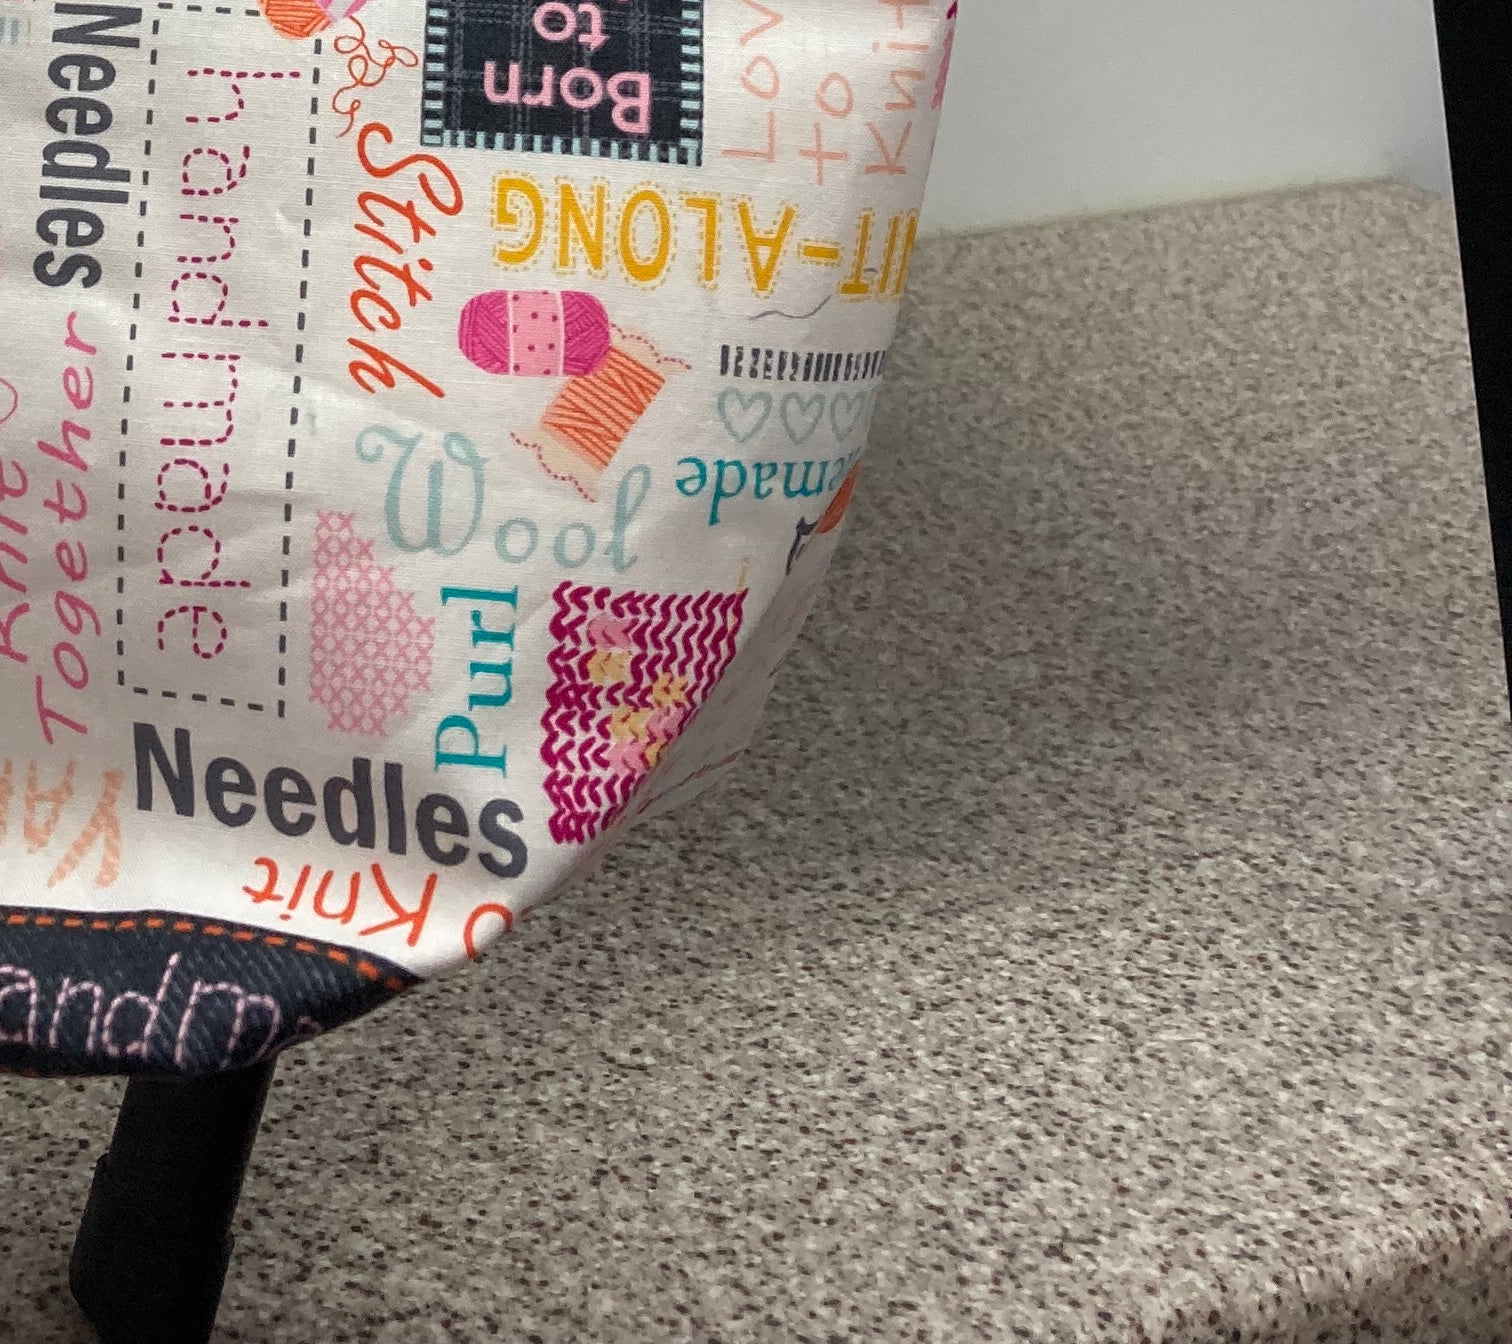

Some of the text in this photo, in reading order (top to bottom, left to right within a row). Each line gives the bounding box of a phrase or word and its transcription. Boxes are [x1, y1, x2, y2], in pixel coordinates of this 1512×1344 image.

[482, 60, 653, 136] Born
[532, 2, 610, 49] to
[32, 2, 143, 289] Needles
[797, 72, 854, 184] to
[347, 121, 464, 399] Stitch
[155, 67, 301, 659] handmade
[35, 310, 100, 745] Together
[354, 424, 653, 574] Wool
[435, 585, 519, 778] Purl
[133, 721, 528, 879] Needles
[243, 857, 438, 947] Knit
